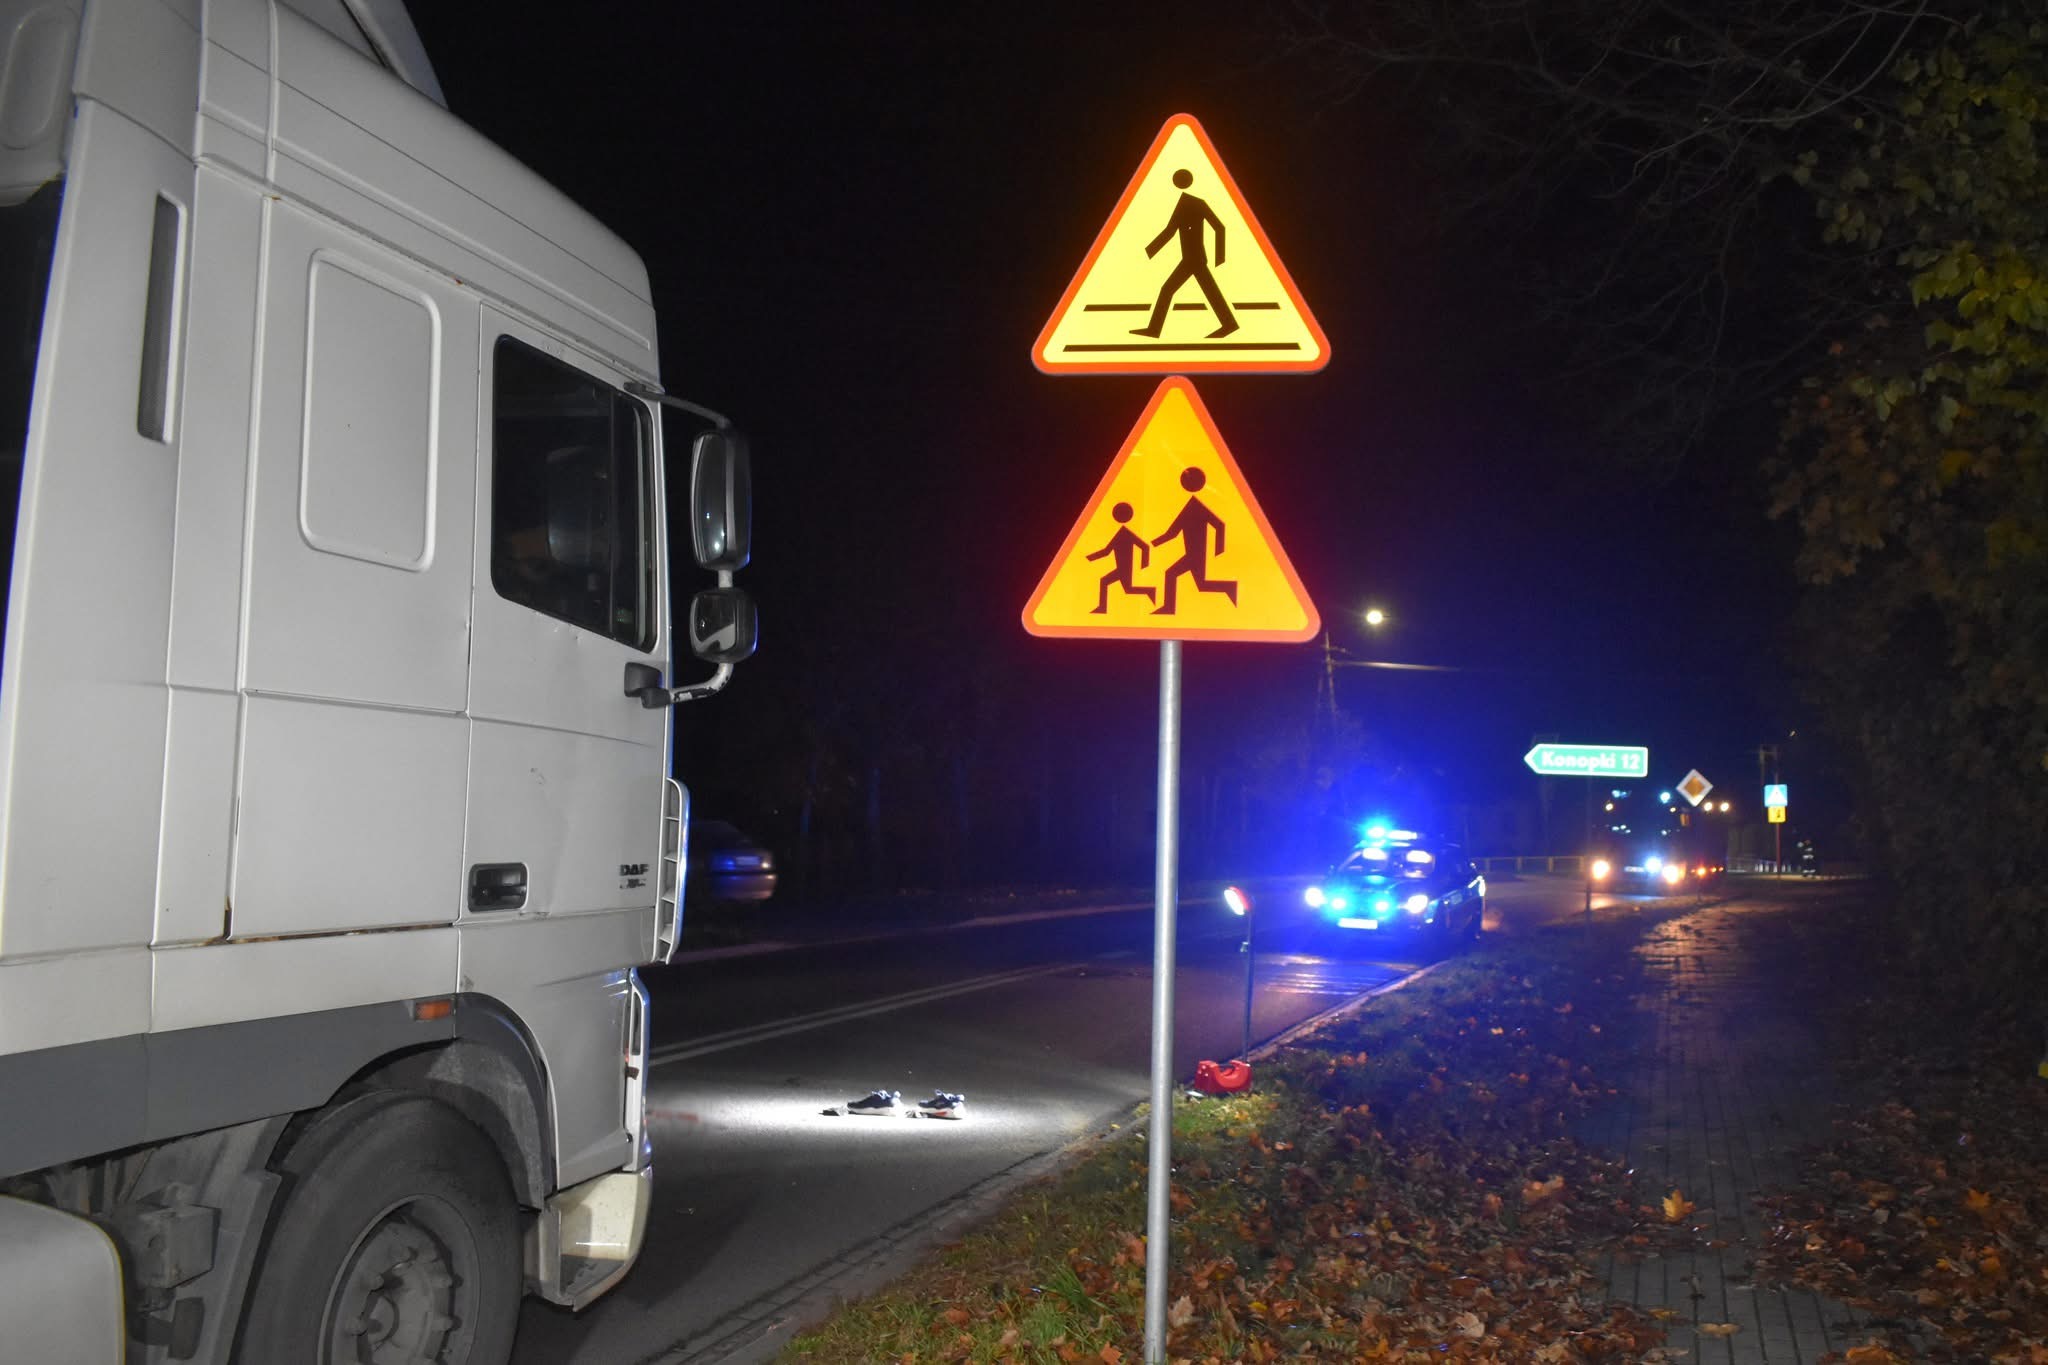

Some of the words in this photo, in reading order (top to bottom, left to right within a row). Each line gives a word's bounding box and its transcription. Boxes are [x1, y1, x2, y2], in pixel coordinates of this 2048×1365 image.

[1541, 750, 1616, 772] Konopki
[1621, 753, 1641, 770] 12
[620, 864, 649, 875] DAF
